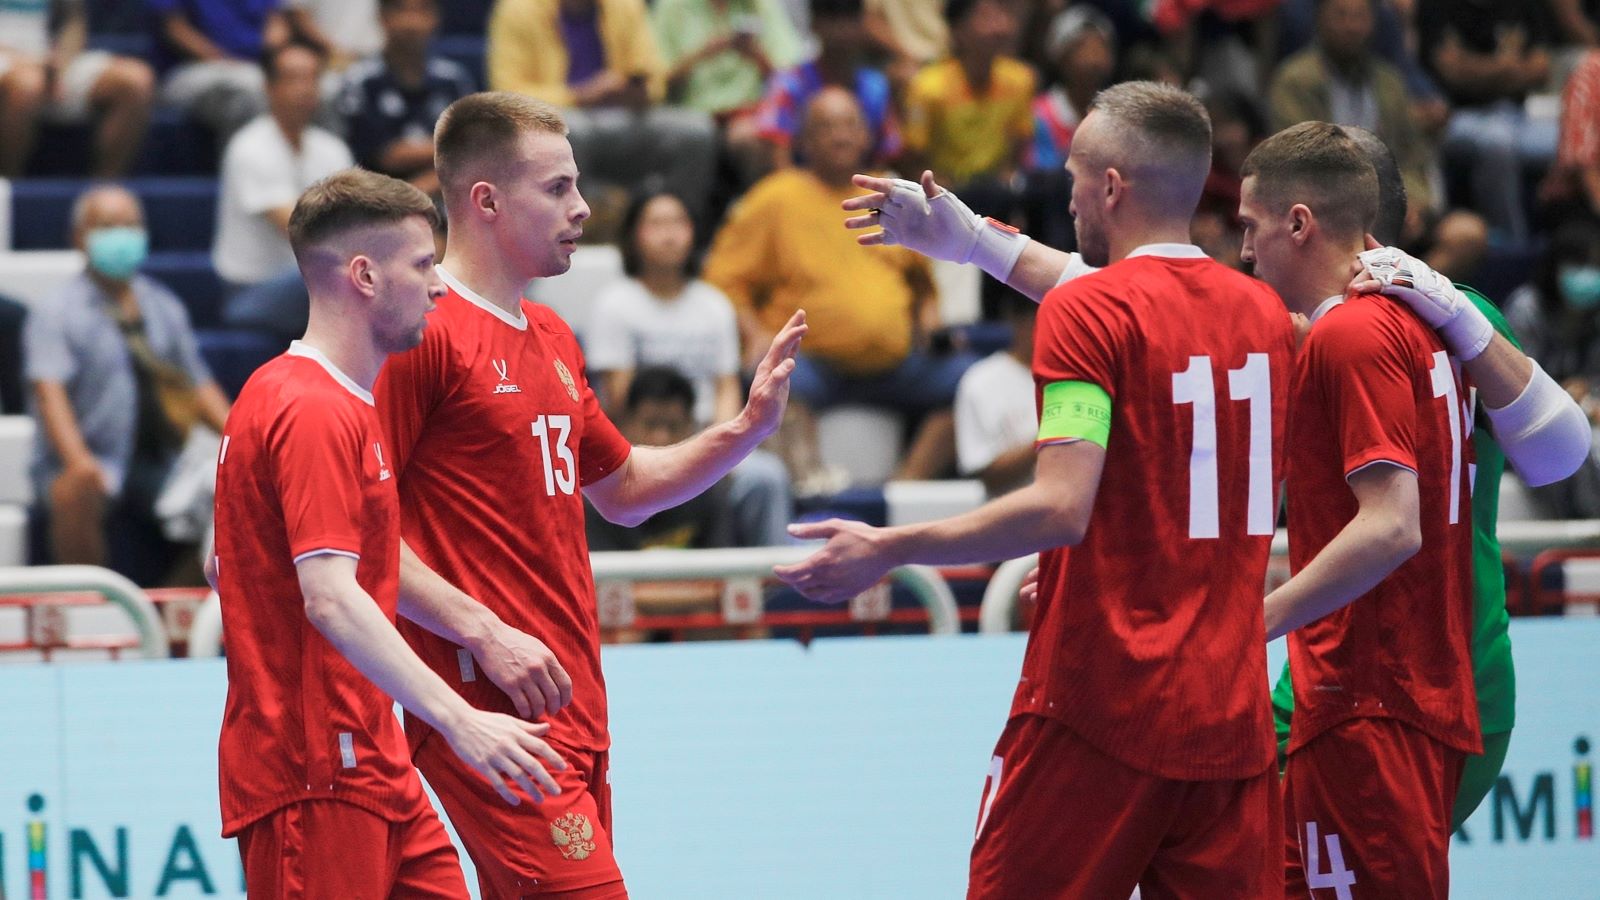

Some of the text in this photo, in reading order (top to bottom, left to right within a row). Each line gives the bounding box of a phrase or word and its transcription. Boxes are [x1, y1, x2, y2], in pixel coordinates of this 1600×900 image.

[531, 414, 576, 496] 13
[1171, 352, 1274, 539] 11
[1456, 735, 1594, 842] Mi
[0, 793, 248, 900] iNA
